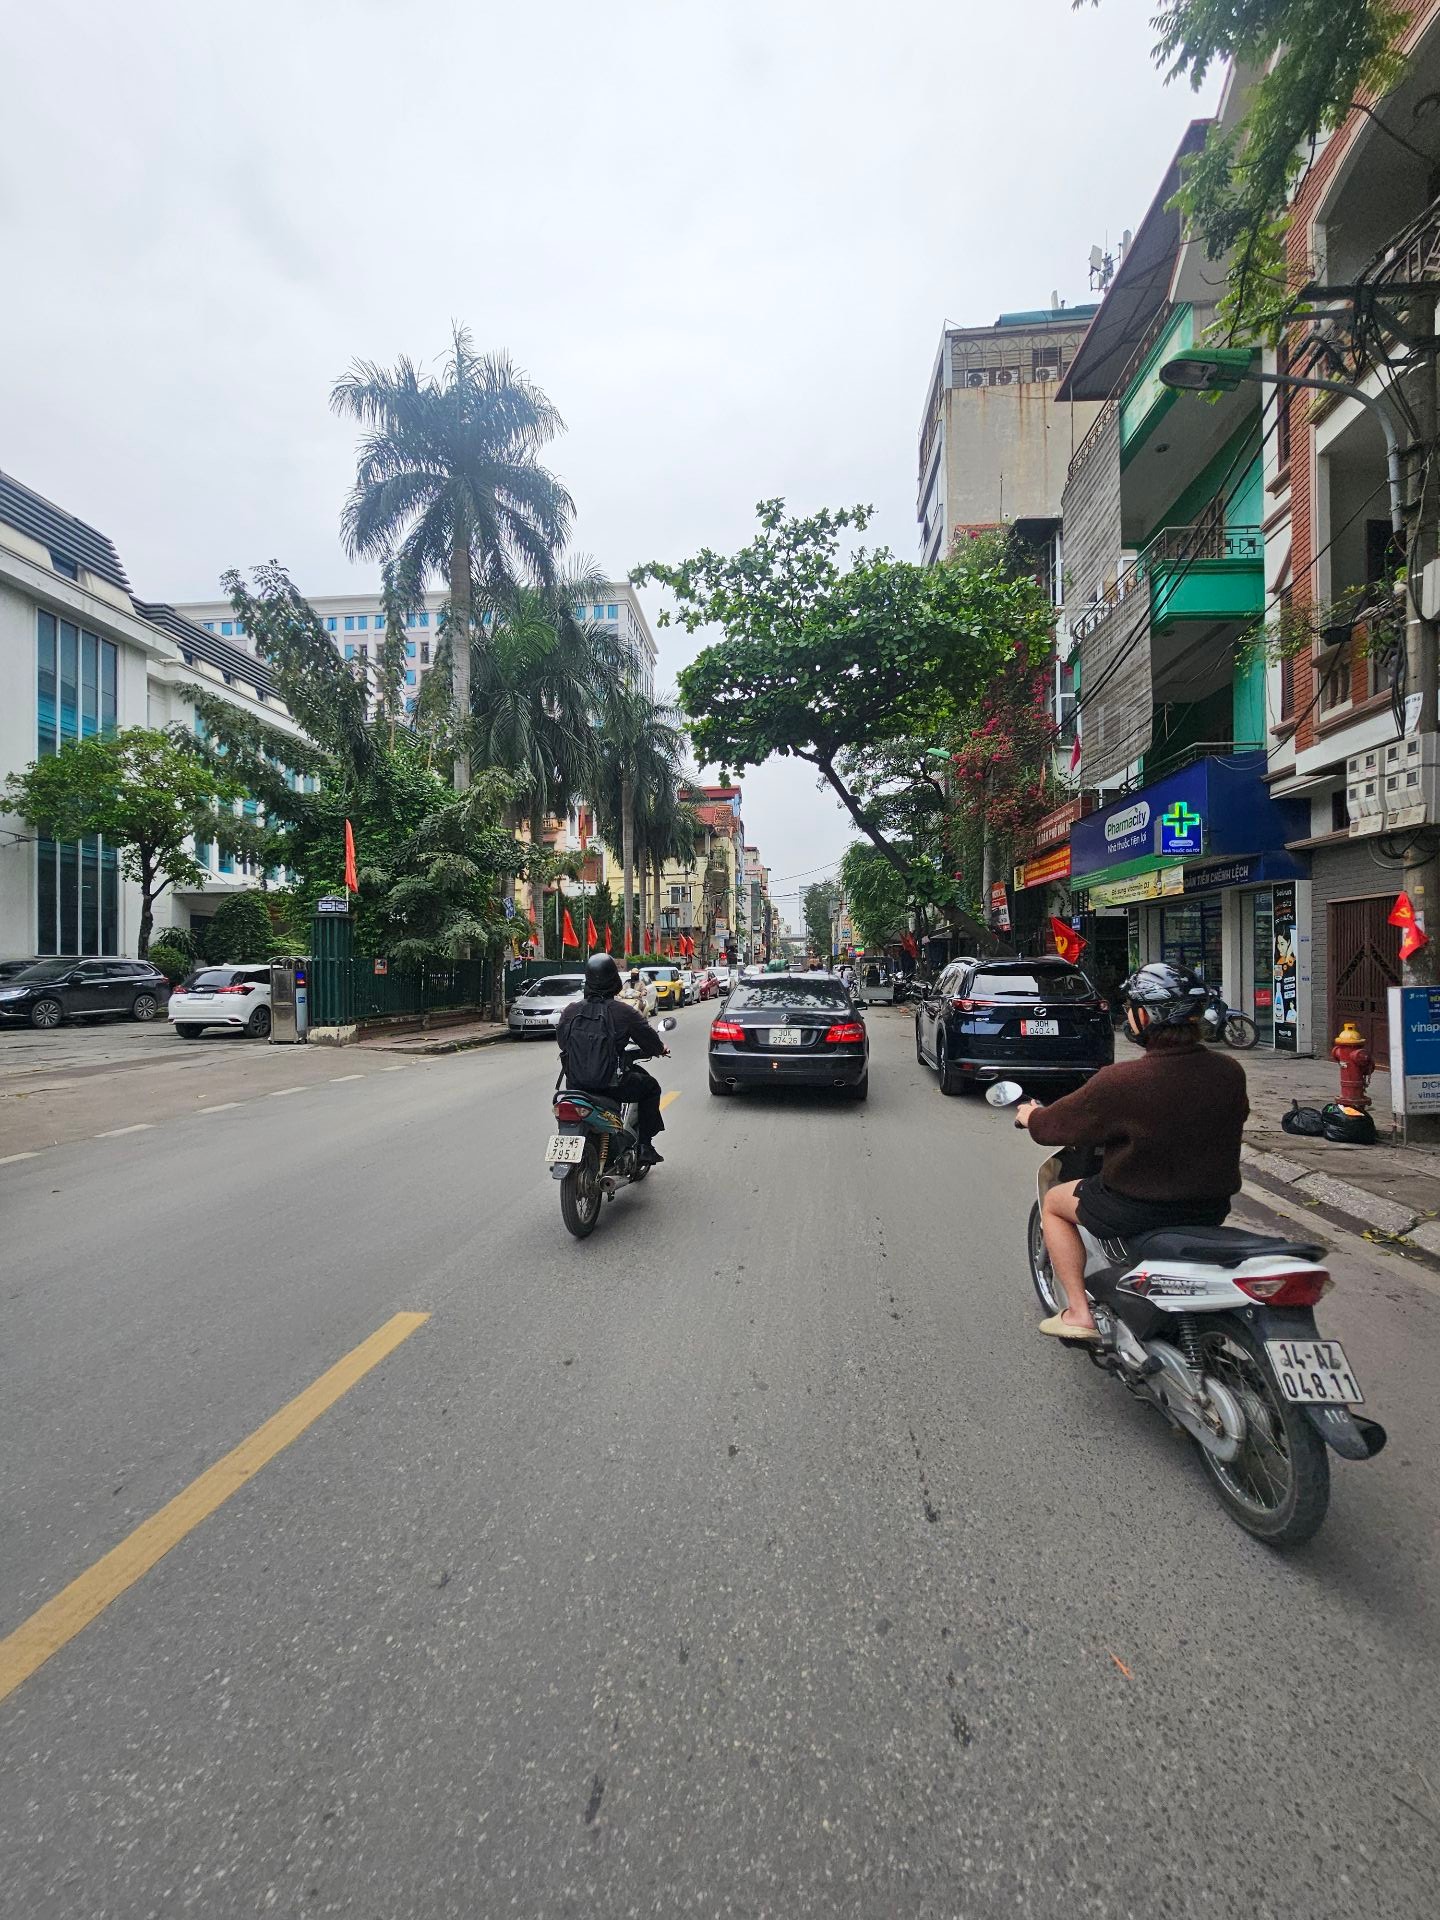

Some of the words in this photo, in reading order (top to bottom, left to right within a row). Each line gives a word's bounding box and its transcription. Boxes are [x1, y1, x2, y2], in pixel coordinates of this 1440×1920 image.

[1107, 809, 1147, 838] Pharmacity
[1107, 842, 1116, 854] Nhà
[1116, 837, 1131, 851] thuốc
[1131, 834, 1140, 849] tiện
[1210, 868, 1231, 883] CHÊNH
[1231, 864, 1249, 882] LỆCH
[1117, 886, 1127, 896] sung
[1127, 881, 1143, 892] vitamin
[1143, 880, 1150, 889] D3
[1029, 1027, 1055, 1035] 040.41
[1034, 1020, 1049, 1028] 30H
[772, 1036, 798, 1045] 274.26
[778, 1029, 792, 1037] 30K
[1279, 1343, 1341, 1370] 14-AZ
[1282, 1372, 1359, 1400] 048.11
